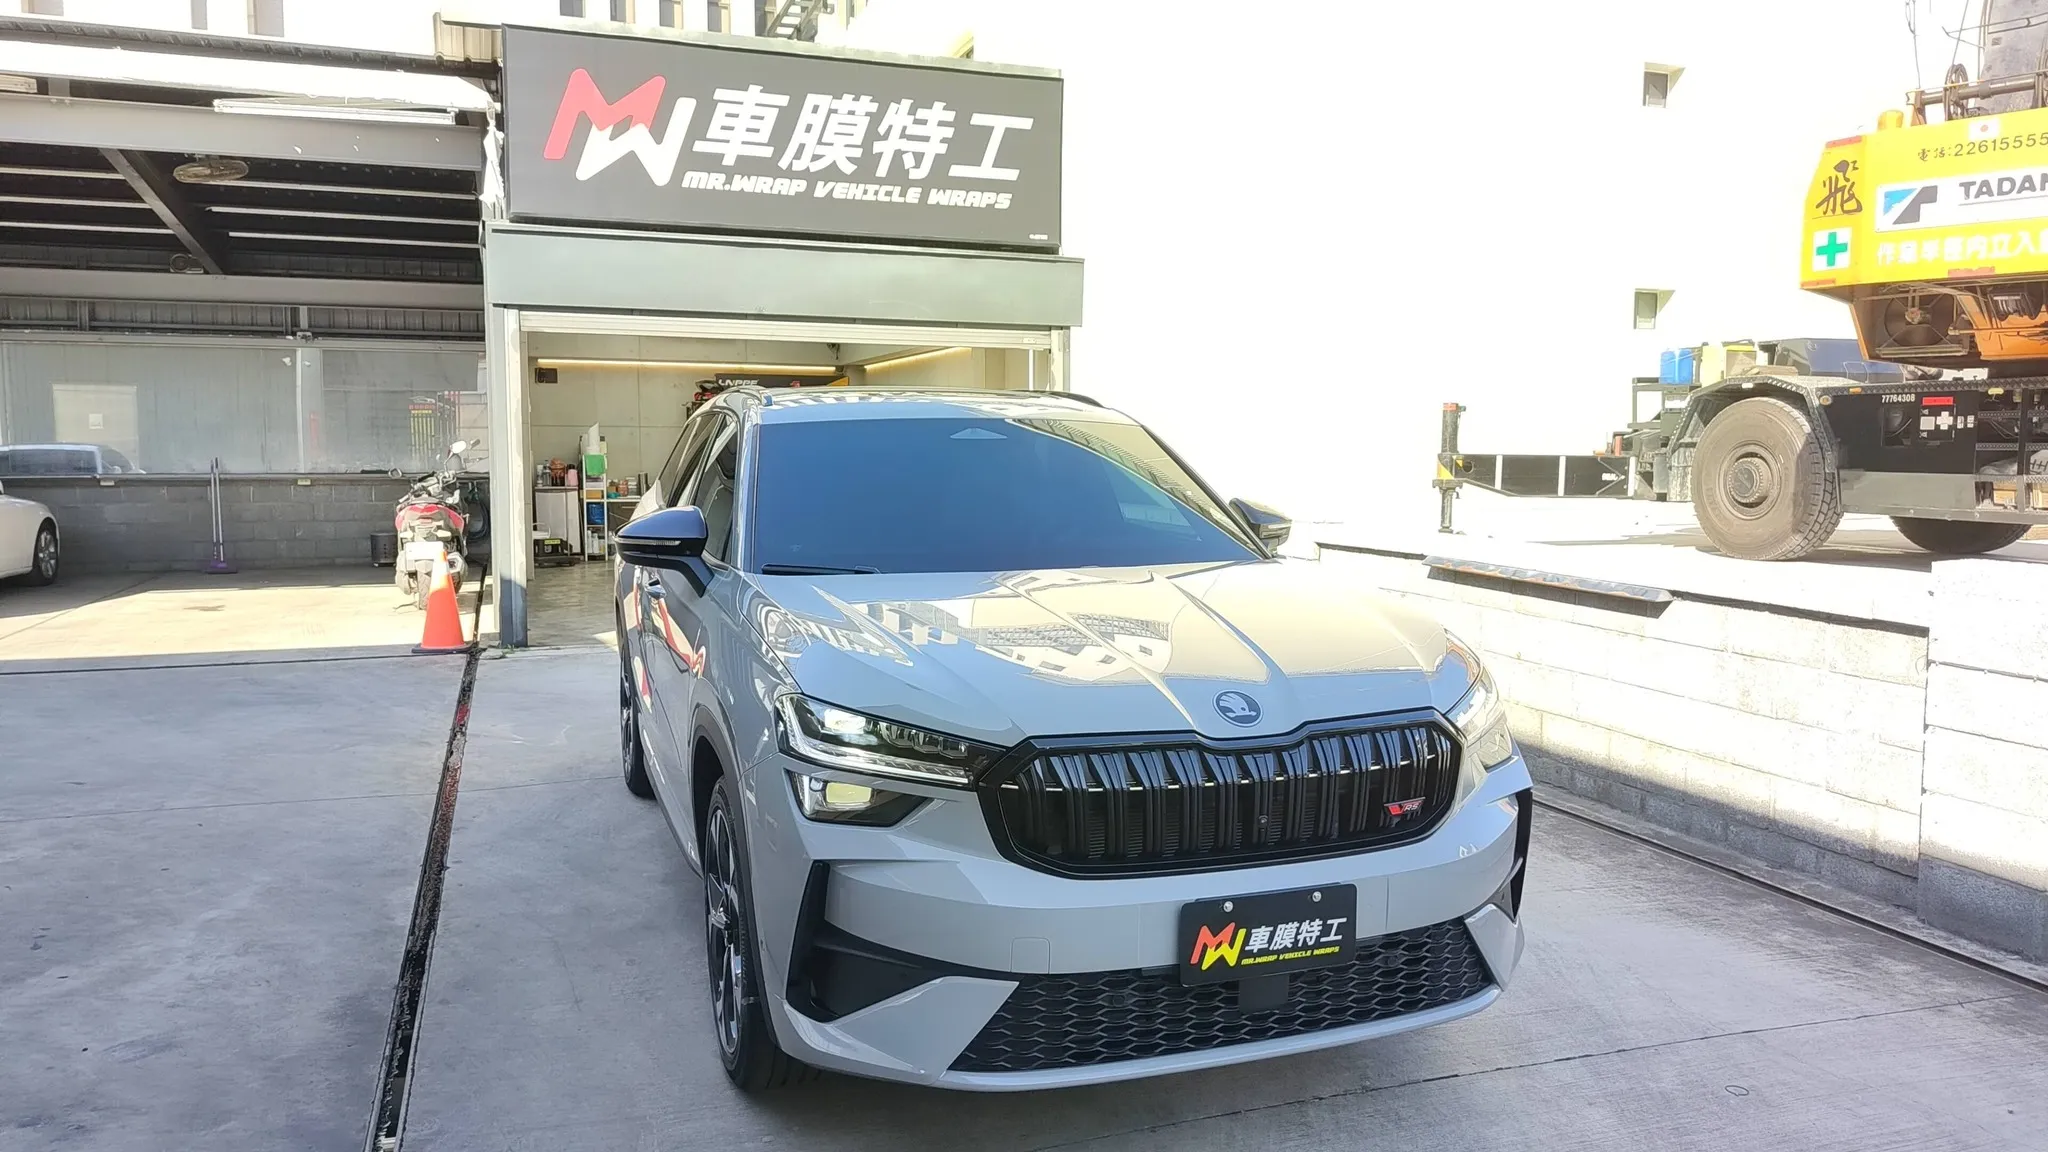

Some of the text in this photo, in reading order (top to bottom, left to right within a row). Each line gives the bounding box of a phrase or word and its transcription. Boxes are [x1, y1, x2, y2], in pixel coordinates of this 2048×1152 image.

[692, 84, 1034, 181] 車膜特工
[681, 171, 1013, 210] MR.WRAP VEHICLE WRAPS
[1881, 394, 1916, 404] 77764308
[1244, 917, 1347, 953] 車膜特工
[1241, 945, 1340, 965] MR.WRAP VEHICLE WRAPS
